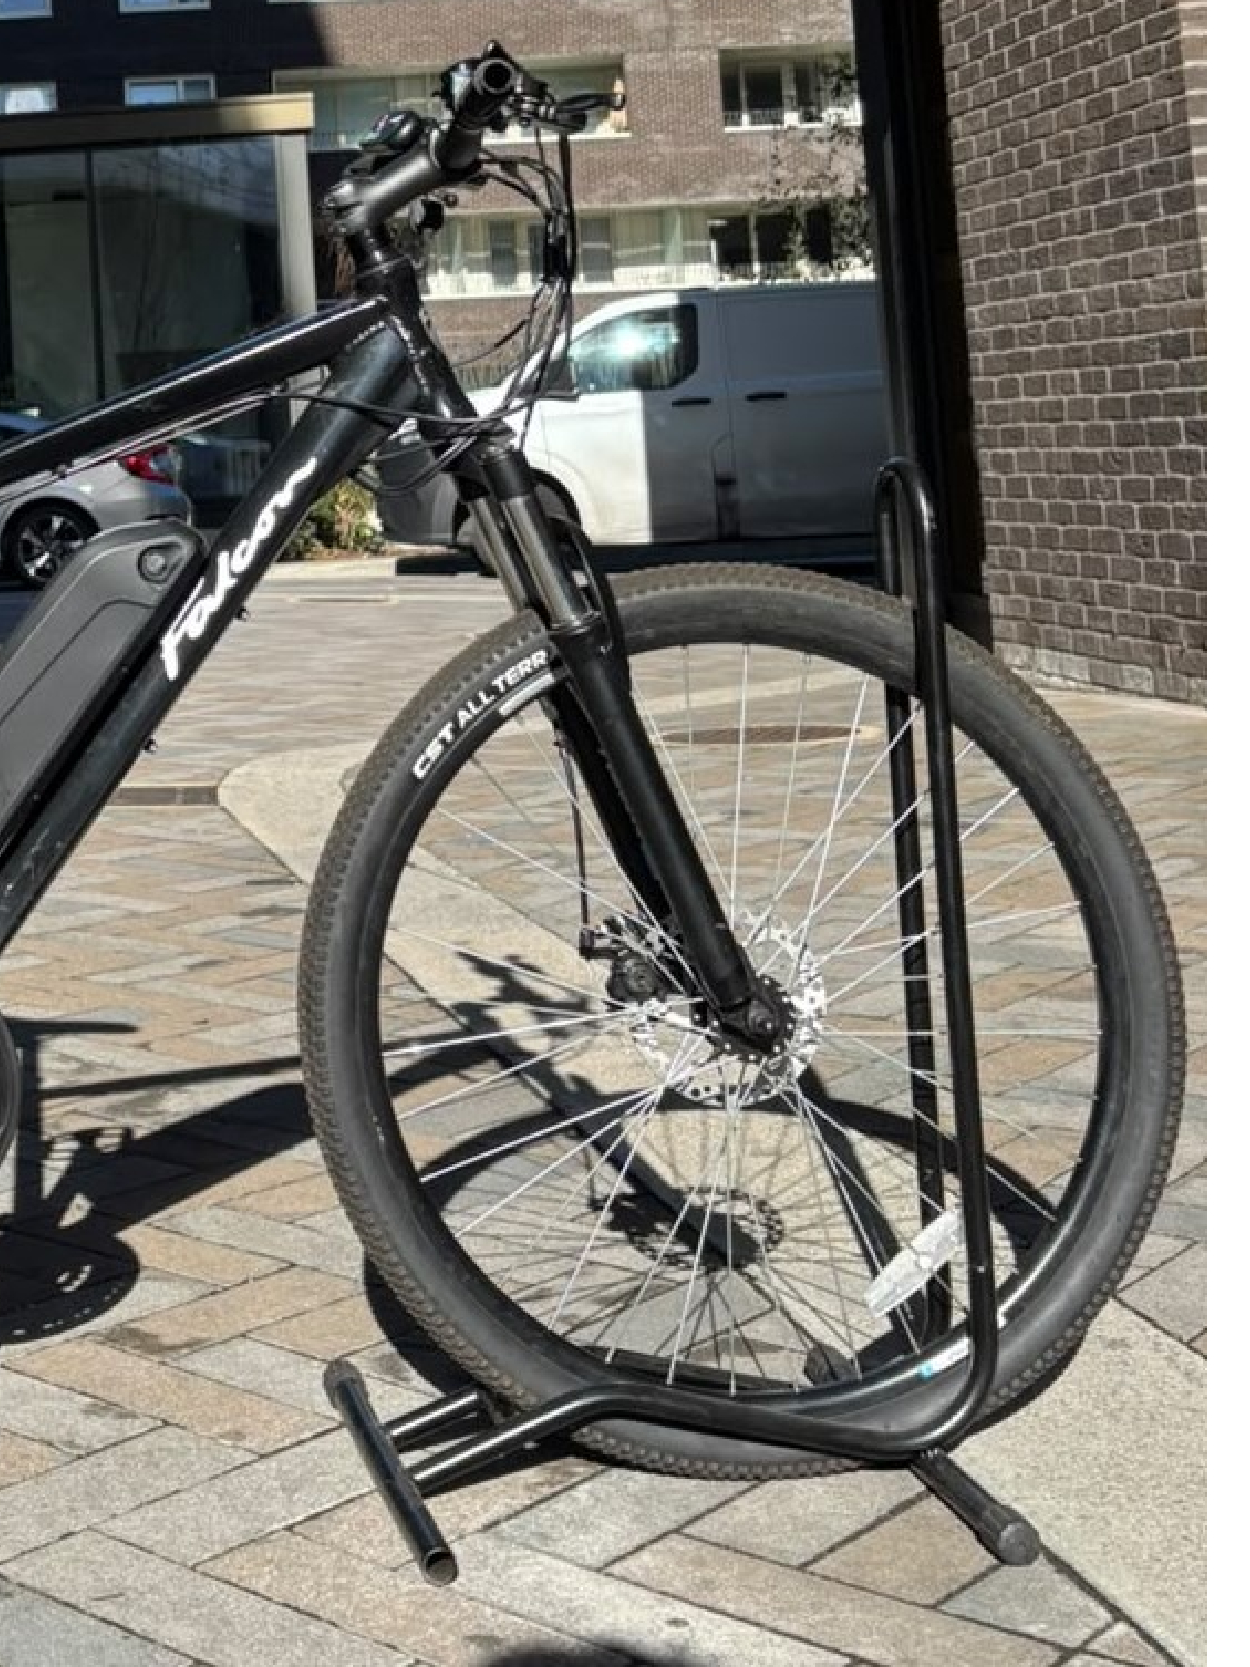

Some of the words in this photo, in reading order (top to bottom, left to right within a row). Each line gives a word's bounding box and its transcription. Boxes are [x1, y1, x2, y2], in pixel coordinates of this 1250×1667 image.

[160, 456, 317, 681] Falcon
[413, 721, 453, 779] CST
[457, 690, 495, 729] ALL
[491, 649, 547, 692] TERR
